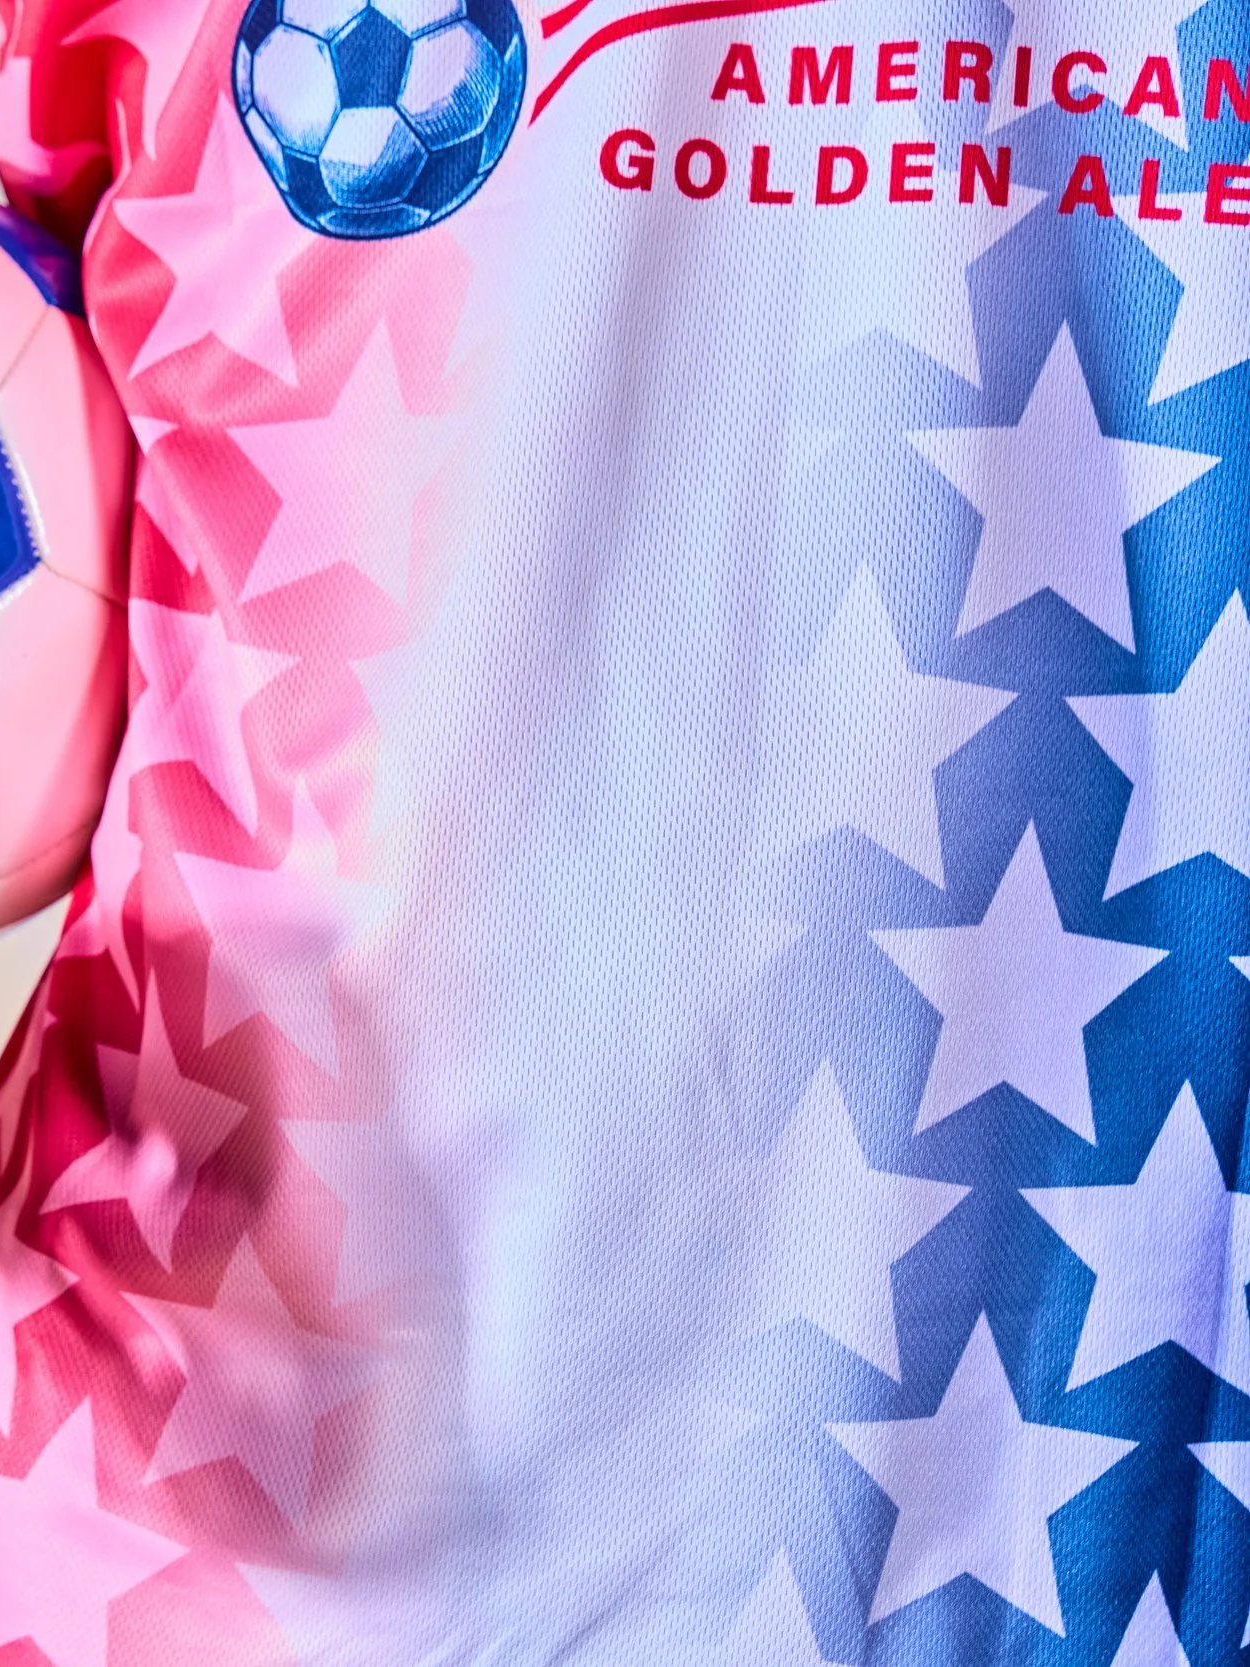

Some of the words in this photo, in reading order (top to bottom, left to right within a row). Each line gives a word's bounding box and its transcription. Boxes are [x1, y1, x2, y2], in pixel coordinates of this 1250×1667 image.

[711, 39, 1250, 123] AMERICAN
[598, 128, 1012, 208] GOLDEN
[1057, 154, 1250, 226] ALE
